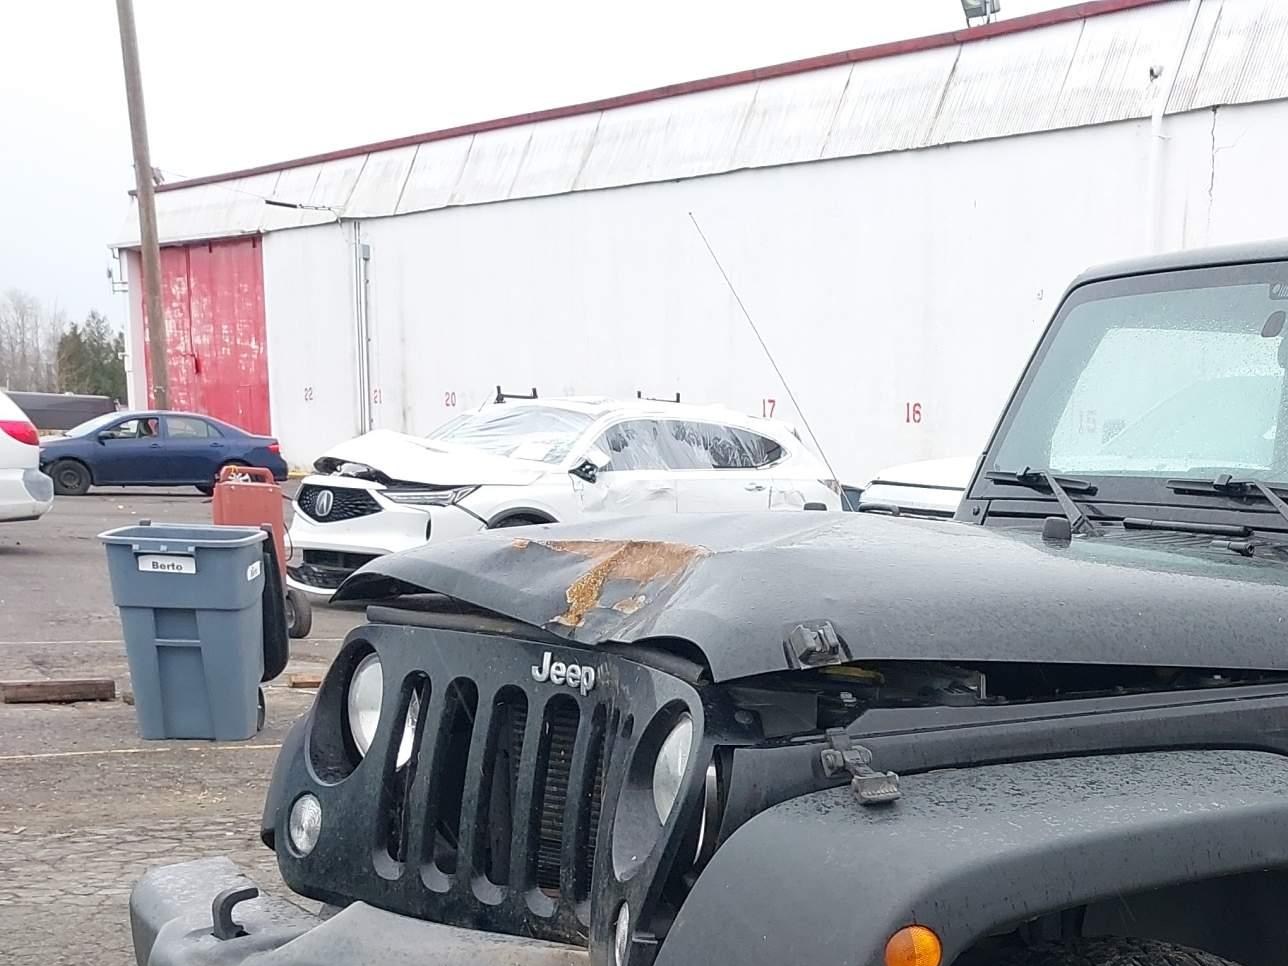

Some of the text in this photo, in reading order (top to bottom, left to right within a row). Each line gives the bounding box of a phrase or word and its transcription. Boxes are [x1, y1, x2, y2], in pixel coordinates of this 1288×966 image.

[304, 388, 313, 401] 22
[373, 390, 382, 404] 21
[445, 392, 456, 407] 20
[763, 399, 776, 418] 17
[906, 402, 922, 423] 16
[151, 561, 183, 571] Berto
[531, 651, 596, 697] Jeep
